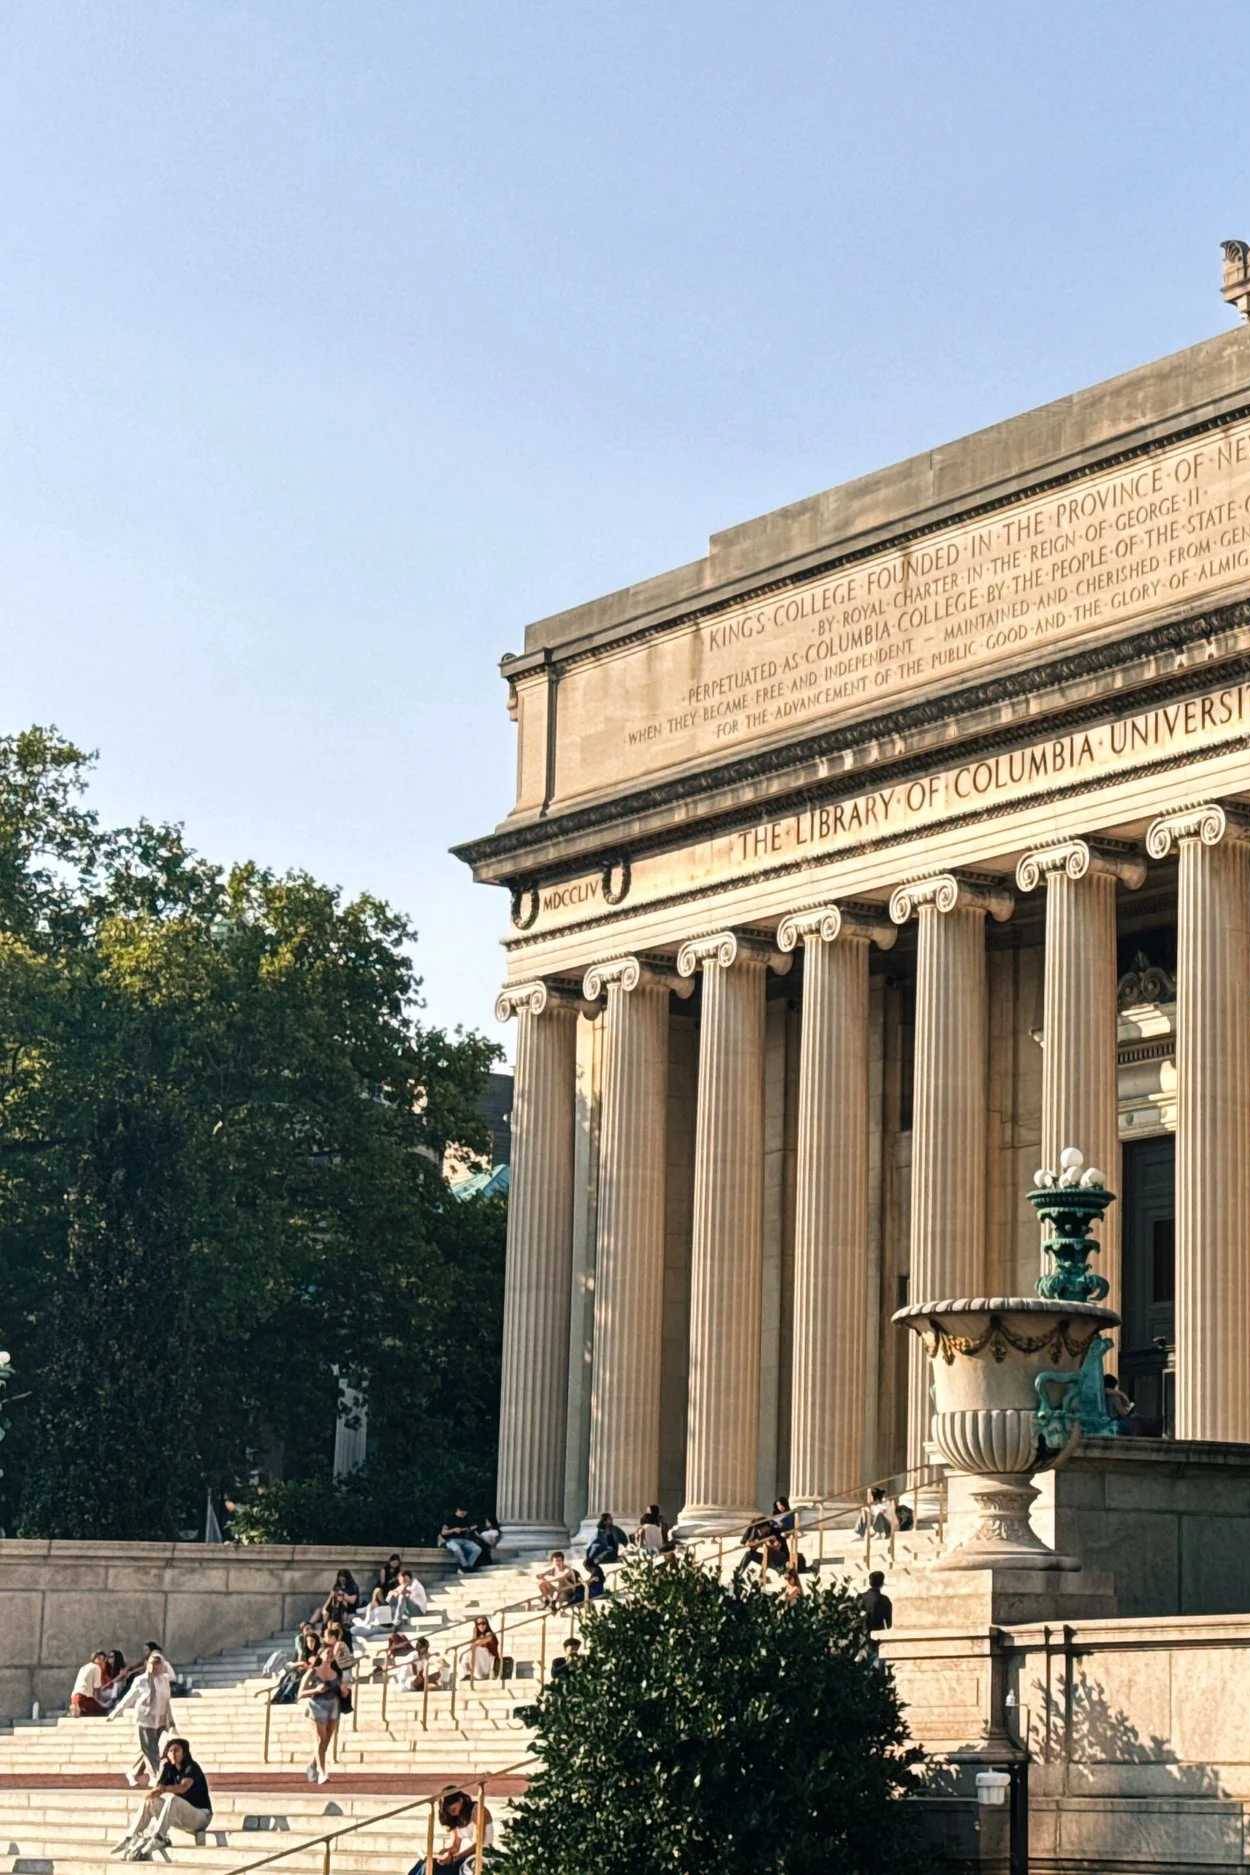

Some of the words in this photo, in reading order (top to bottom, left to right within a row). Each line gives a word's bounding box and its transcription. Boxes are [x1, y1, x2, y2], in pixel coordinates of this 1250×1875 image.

[688, 661, 777, 706] PERPETUATED
[782, 652, 799, 674] AS
[805, 620, 891, 664] COLUMBIA
[897, 588, 978, 632] COLLEGE
[987, 580, 1005, 604] BY
[1012, 568, 1044, 595] THE
[1052, 545, 1107, 581] PEOPLE
[1115, 535, 1139, 558] OF
[1144, 520, 1179, 549] THE
[1187, 500, 1236, 535] STATE
[773, 579, 857, 627] COLLEGE
[867, 543, 960, 595] FOUNDED
[971, 530, 992, 558] IN
[1002, 511, 1044, 546] THE
[1056, 467, 1163, 528] PROVINCE
[1175, 453, 1204, 484] OF
[818, 615, 835, 636] BY
[843, 599, 886, 627] ROYAL
[893, 572, 959, 609] CHARTER
[967, 563, 983, 585] IN
[990, 551, 1021, 576] THE
[1030, 530, 1076, 563] REIGN
[1085, 520, 1106, 542] OF
[1115, 495, 1180, 531] GEORGE
[628, 723, 662, 745] WHEN
[667, 711, 697, 733] THEY
[703, 694, 748, 721] BECAME
[756, 682, 784, 704] FREE
[790, 671, 817, 693] AND
[825, 638, 914, 681] INDEPENDENT
[944, 600, 1030, 641] MAINTAINED
[1037, 586, 1068, 607] AND
[1075, 555, 1159, 595] CHERISHED
[1169, 538, 1211, 567] FROM
[717, 720, 739, 739] FOR
[745, 709, 768, 729] THE
[775, 675, 869, 720] ADVANCEMENT
[874, 668, 893, 686] OF
[898, 657, 924, 679] THE
[931, 640, 977, 669] PUBLIC
[986, 624, 1028, 650] GOOD
[1035, 611, 1066, 636] AND
[1073, 599, 1101, 622] THE
[1111, 579, 1161, 609] GLORY
[1169, 569, 1189, 590] OF
[738, 822, 782, 861] THE
[796, 789, 896, 845] LIBRARY
[907, 776, 941, 812] OF
[954, 733, 1095, 799] COLUMBIA
[543, 880, 598, 912] MDCCLIV
